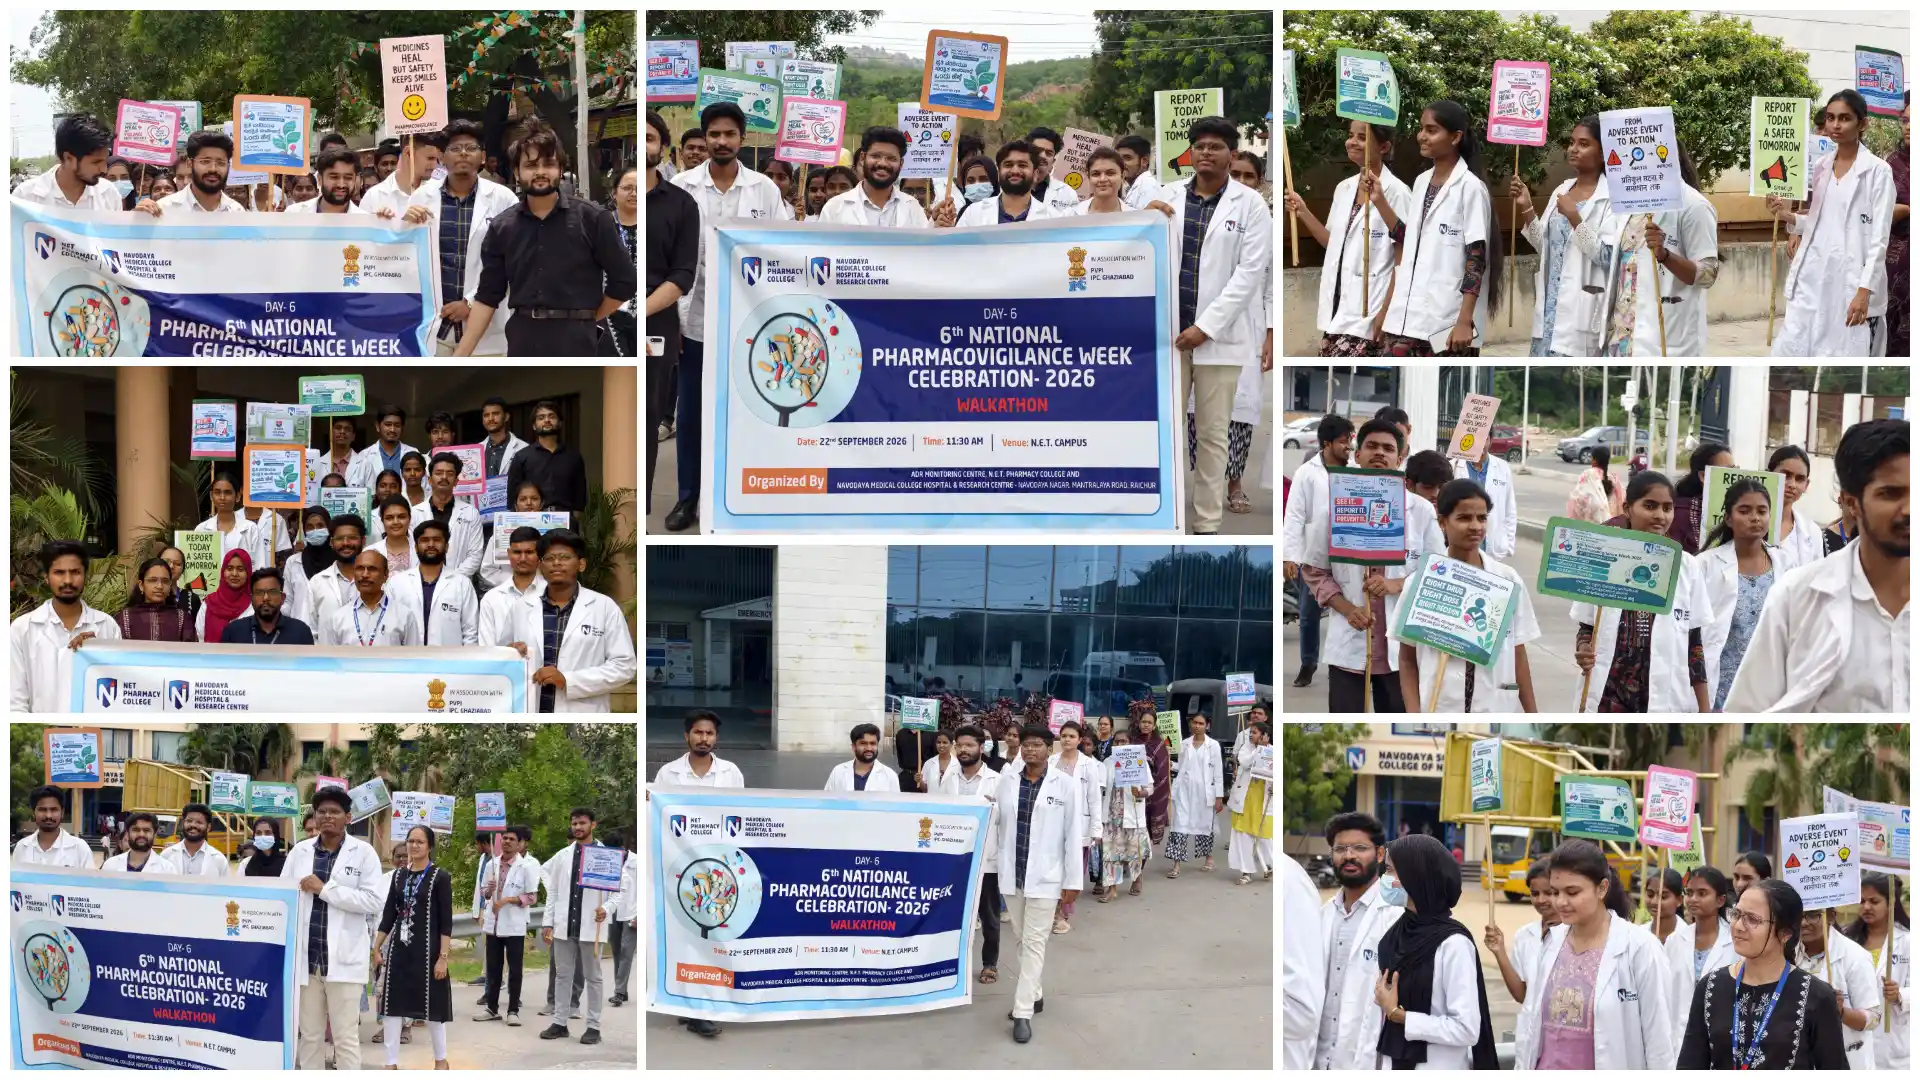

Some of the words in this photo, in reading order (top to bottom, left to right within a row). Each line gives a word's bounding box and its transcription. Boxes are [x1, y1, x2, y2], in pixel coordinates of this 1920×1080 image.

[393, 43, 430, 52] MEDICINES
[402, 53, 423, 63] HEAL
[393, 65, 406, 74] BUT
[409, 64, 434, 73] SAFETY
[392, 75, 412, 83] KEEPS
[415, 73, 437, 81] SMILES
[405, 84, 424, 92] ALIVE
[1170, 93, 1208, 103] REPORT
[1174, 107, 1204, 116] TODAY
[1765, 102, 1797, 113] REPORT
[1171, 119, 1177, 128] A
[1624, 118, 1643, 126] FROM
[1767, 115, 1793, 126] TODAY
[1608, 126, 1639, 137] ADVERSE
[1640, 124, 1664, 135] EVENT
[1764, 129, 1769, 138] A
[1772, 129, 1795, 139] SAFER
[1072, 134, 1101, 145] MEDICINES
[1617, 138, 1627, 146] TO
[1629, 136, 1656, 145] ACTION
[1076, 143, 1092, 151] HEAL
[1759, 140, 1801, 152] TOMORROW
[1064, 155, 1079, 163] KEEPS
[265, 302, 287, 313] DAY-
[289, 302, 296, 313] 6
[984, 308, 1008, 320] DAY-
[1010, 308, 1018, 320] 6
[226, 319, 247, 336] 6th
[251, 318, 337, 337] NATIONAL
[940, 326, 964, 344] 6th
[969, 326, 1063, 344] NATIONAL
[352, 339, 401, 356] WEEK
[872, 347, 1073, 367] PHARMACOVIGILANCE
[1079, 346, 1133, 365] WEEK
[908, 369, 1040, 389] CELEBRATION-
[1045, 369, 1096, 388] 2026
[957, 397, 1049, 413] WALKATHON
[797, 438, 818, 446] Date:
[819, 437, 836, 445] 22nd
[838, 437, 884, 446] SEPTEMBER
[886, 437, 907, 445] 2026
[923, 437, 945, 445] Time:
[946, 437, 970, 446] 11:30
[971, 437, 984, 445] AM
[1002, 439, 1029, 447] Venue:
[1031, 438, 1053, 447] N.E.T.
[1054, 438, 1087, 447] CAMPUS
[748, 475, 806, 489] Organized
[809, 476, 825, 489] By
[186, 534, 213, 542] REPORT
[185, 562, 218, 570] OMORROW
[1426, 578, 1447, 590] RIGHT
[1446, 584, 1464, 596] DRUG
[1422, 589, 1443, 600] RIGHT
[1442, 594, 1460, 605] DOSE
[123, 690, 161, 698] PHARMACY
[123, 698, 151, 706] COLLEGE
[1379, 751, 1433, 762] NAVODAYA
[1379, 762, 1419, 771] COLLEGE
[1422, 763, 1433, 771] OF
[1808, 824, 1826, 832] FROM
[1789, 832, 1822, 843] ADVERSE
[1824, 829, 1849, 839] EVENT
[1799, 842, 1809, 850] TO
[1812, 839, 1839, 848] ACTION
[1672, 853, 1700, 862] TOMORROW
[821, 869, 839, 882] 6th
[843, 869, 910, 885] NATIONAL
[769, 884, 917, 899] PHARMACOVIGILANCE
[920, 884, 953, 901] WEEK
[796, 900, 891, 913] CELEBRATION-
[895, 902, 930, 916] 2026
[831, 920, 897, 931] WALKATHON
[139, 954, 156, 967] 6th
[159, 956, 224, 974] NATIONAL
[680, 968, 721, 981] Organized
[96, 965, 232, 991] PHARMACOVIGILANCE
[235, 978, 268, 997] WEEK
[121, 984, 209, 1005] CELEBRATION-
[213, 993, 246, 1010] 2026
[153, 1008, 216, 1023] WALKATHON
[81, 1025, 109, 1034] SEPTEMBER
[110, 1028, 124, 1036] 2026
